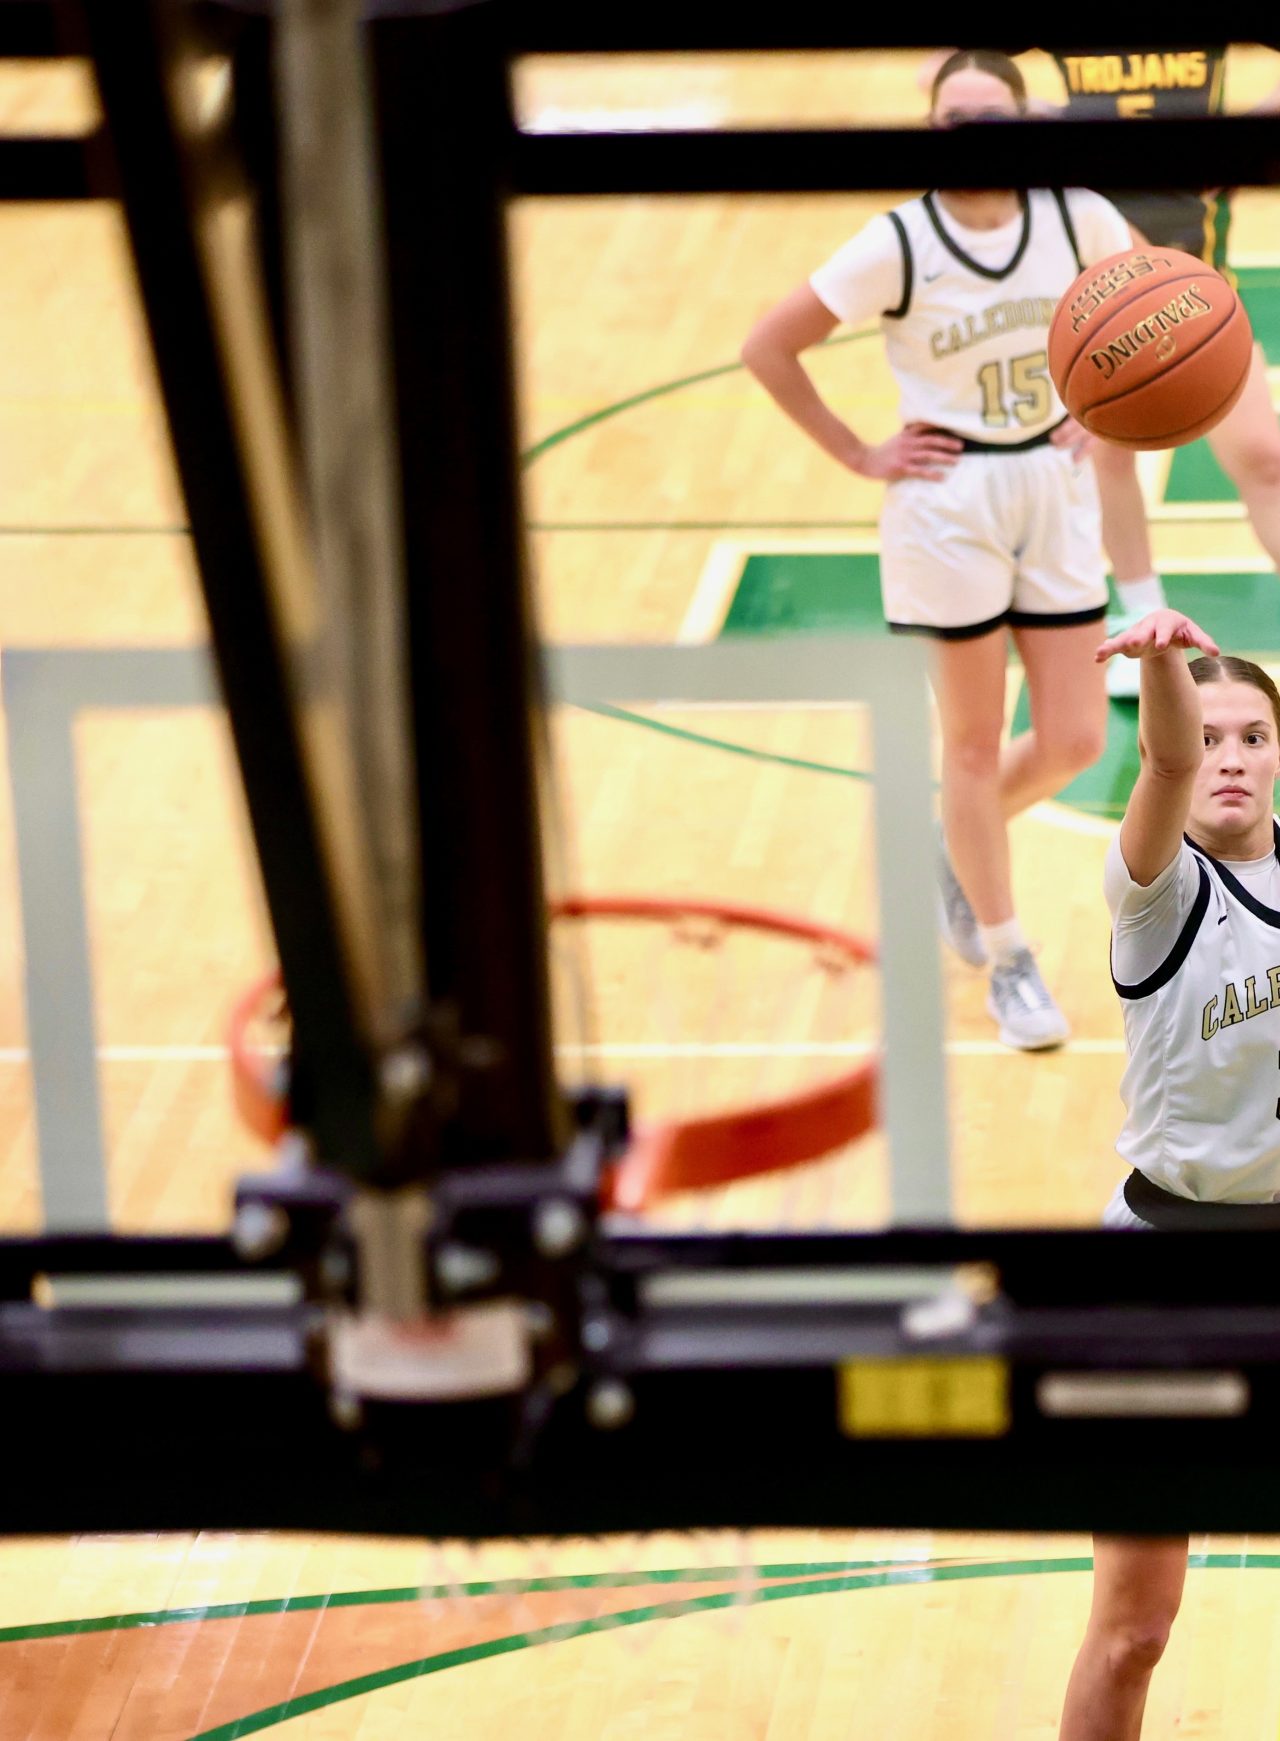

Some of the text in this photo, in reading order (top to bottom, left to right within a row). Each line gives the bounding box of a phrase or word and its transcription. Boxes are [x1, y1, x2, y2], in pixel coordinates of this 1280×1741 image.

[1063, 51, 1208, 94] TROJANS
[930, 297, 1060, 360] CALEDON
[1071, 256, 1173, 333] LEGACY
[1090, 283, 1213, 381] SPALDING
[978, 351, 1052, 427] 15
